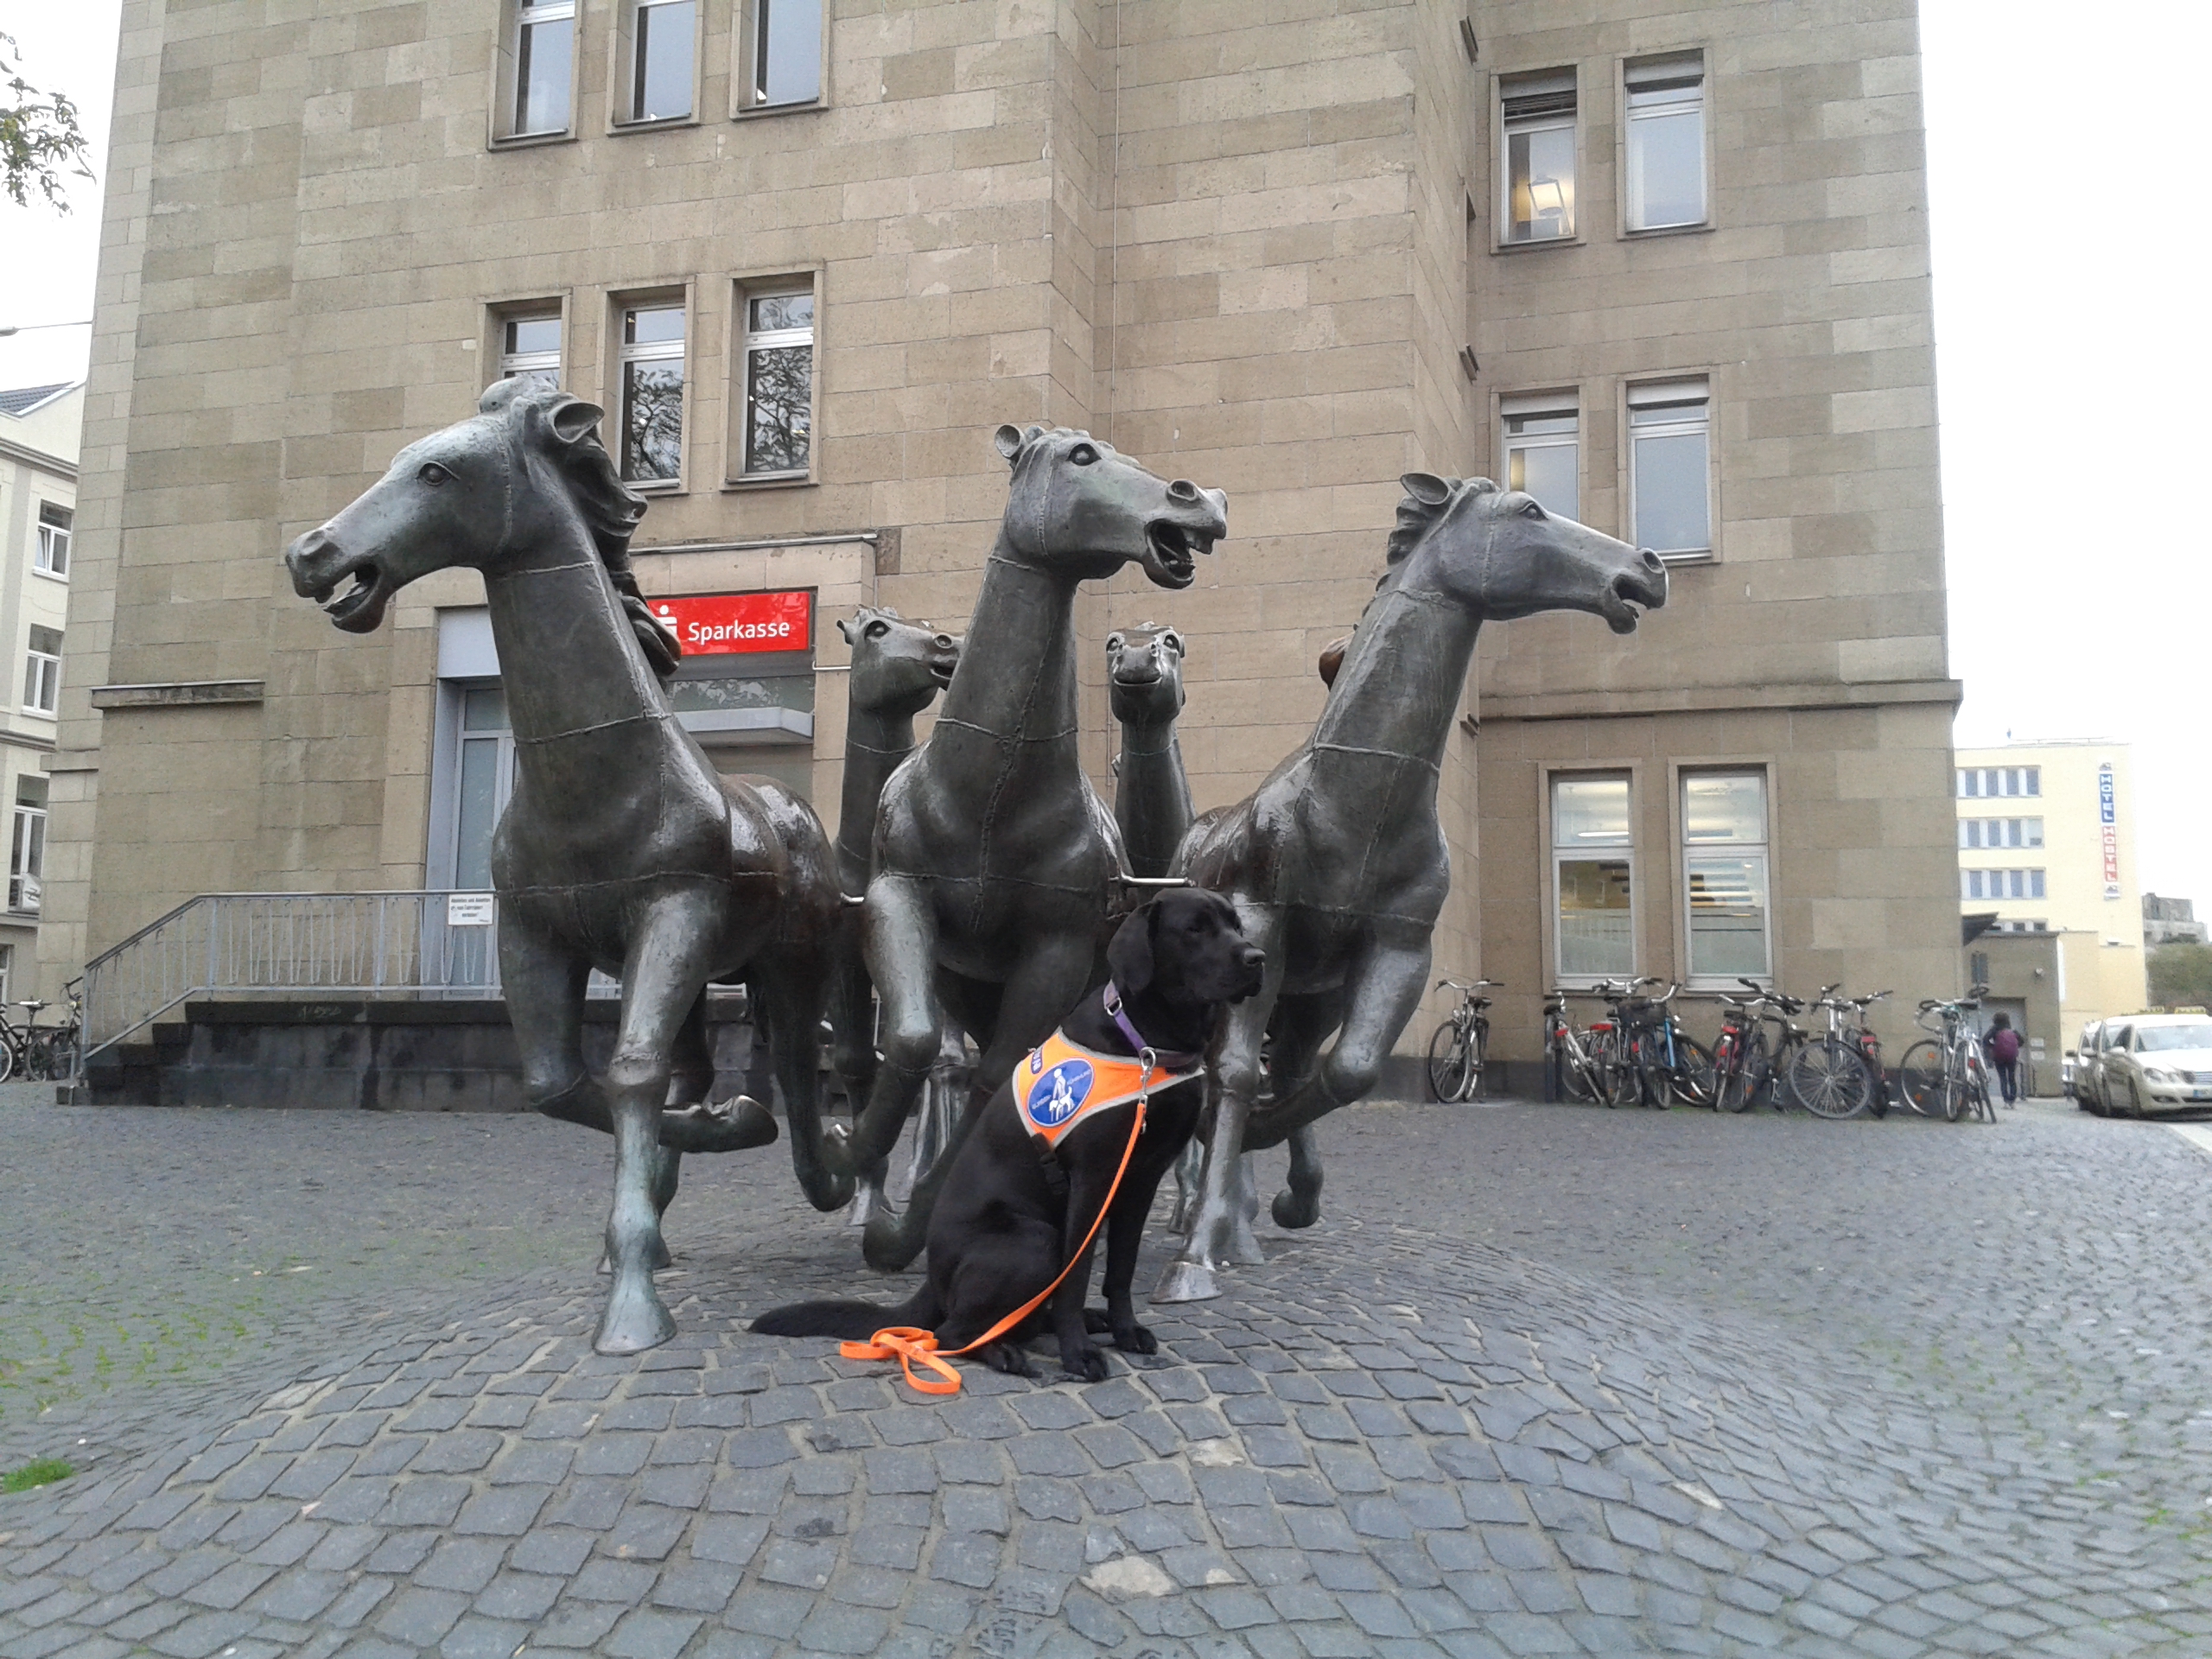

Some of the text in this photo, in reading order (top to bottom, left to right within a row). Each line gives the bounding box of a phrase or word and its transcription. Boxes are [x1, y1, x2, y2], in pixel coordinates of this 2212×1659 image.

[688, 620, 790, 645] Sparkasse
[2101, 775, 2113, 821] HOTEL
[2103, 827, 2117, 881] HOSTEL
